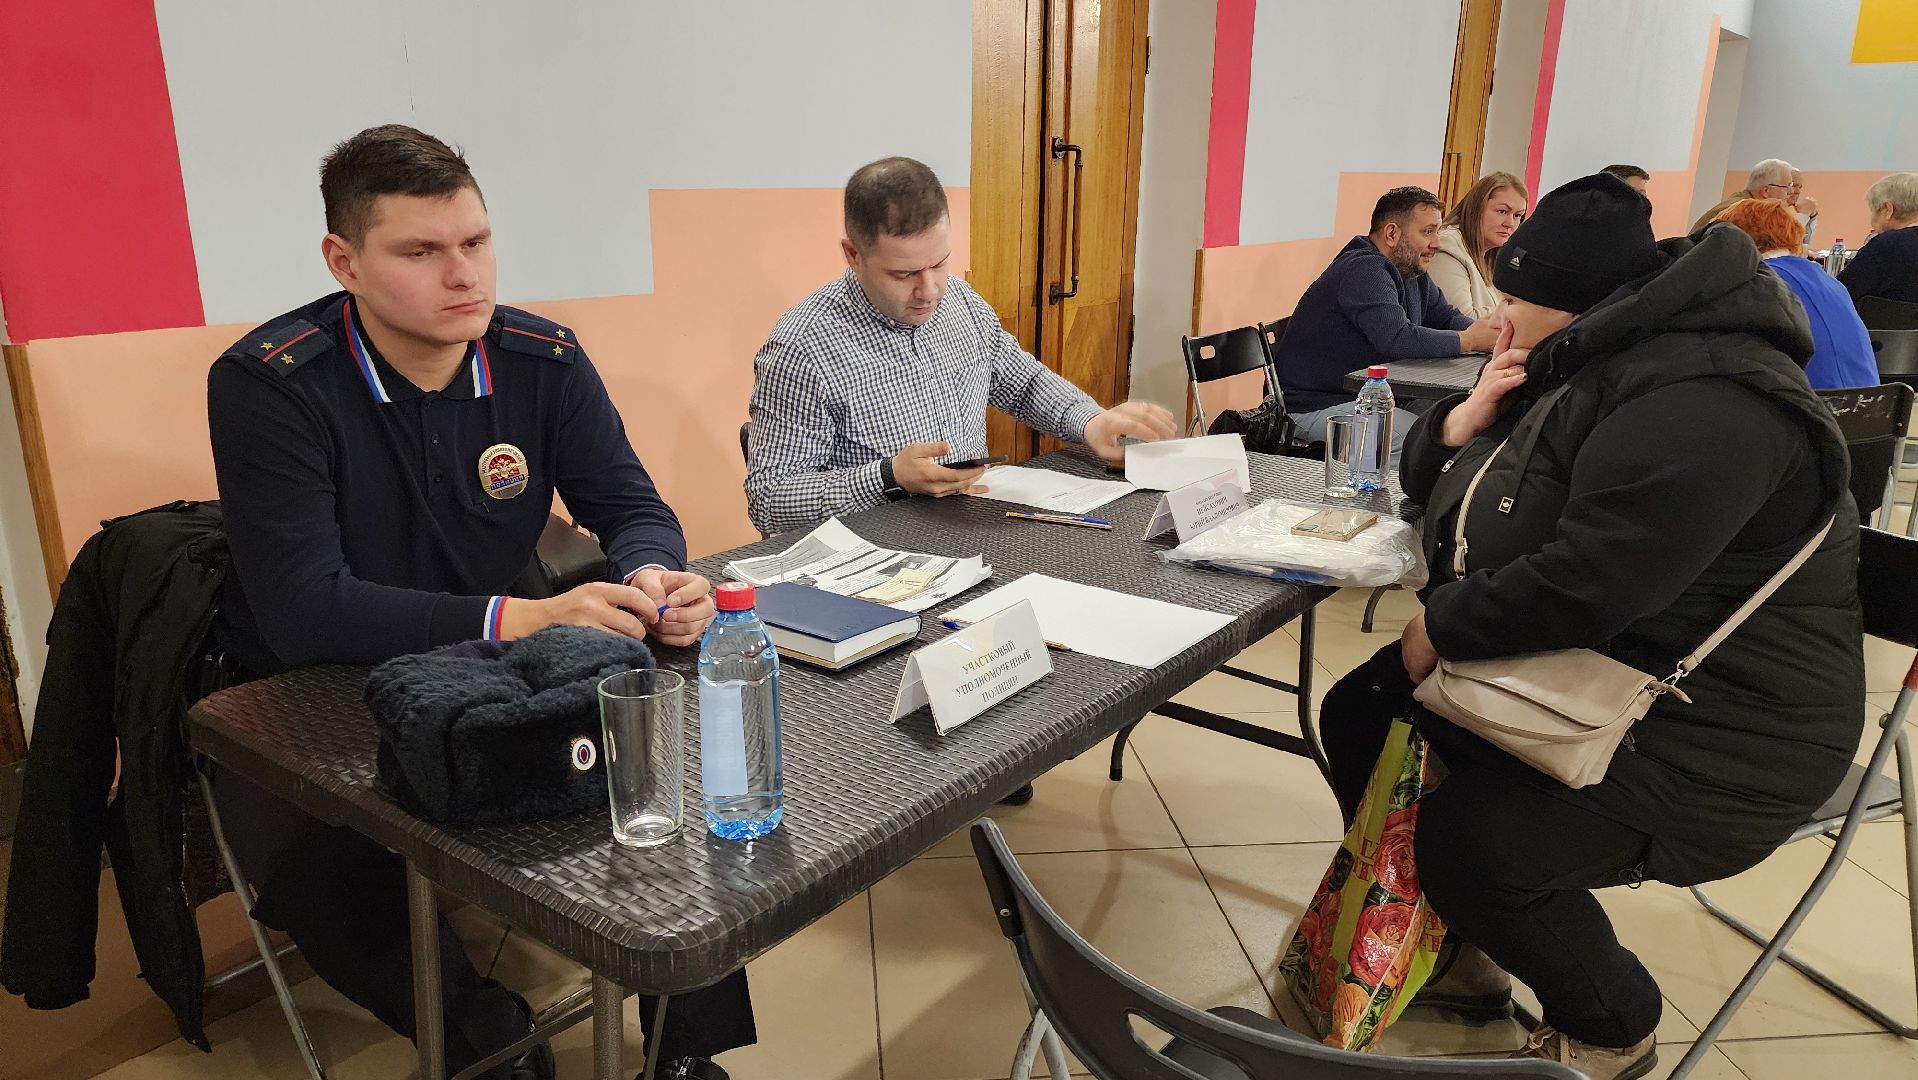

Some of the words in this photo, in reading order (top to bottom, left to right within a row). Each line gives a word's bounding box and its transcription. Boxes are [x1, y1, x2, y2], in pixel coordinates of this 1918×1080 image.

[955, 648, 1032, 697] УПОЛНОМОЧЕННЫЙ
[962, 640, 1016, 674] УЧАСТКОВЫЙ
[981, 675, 1019, 702] ПОЛИЦИИ
